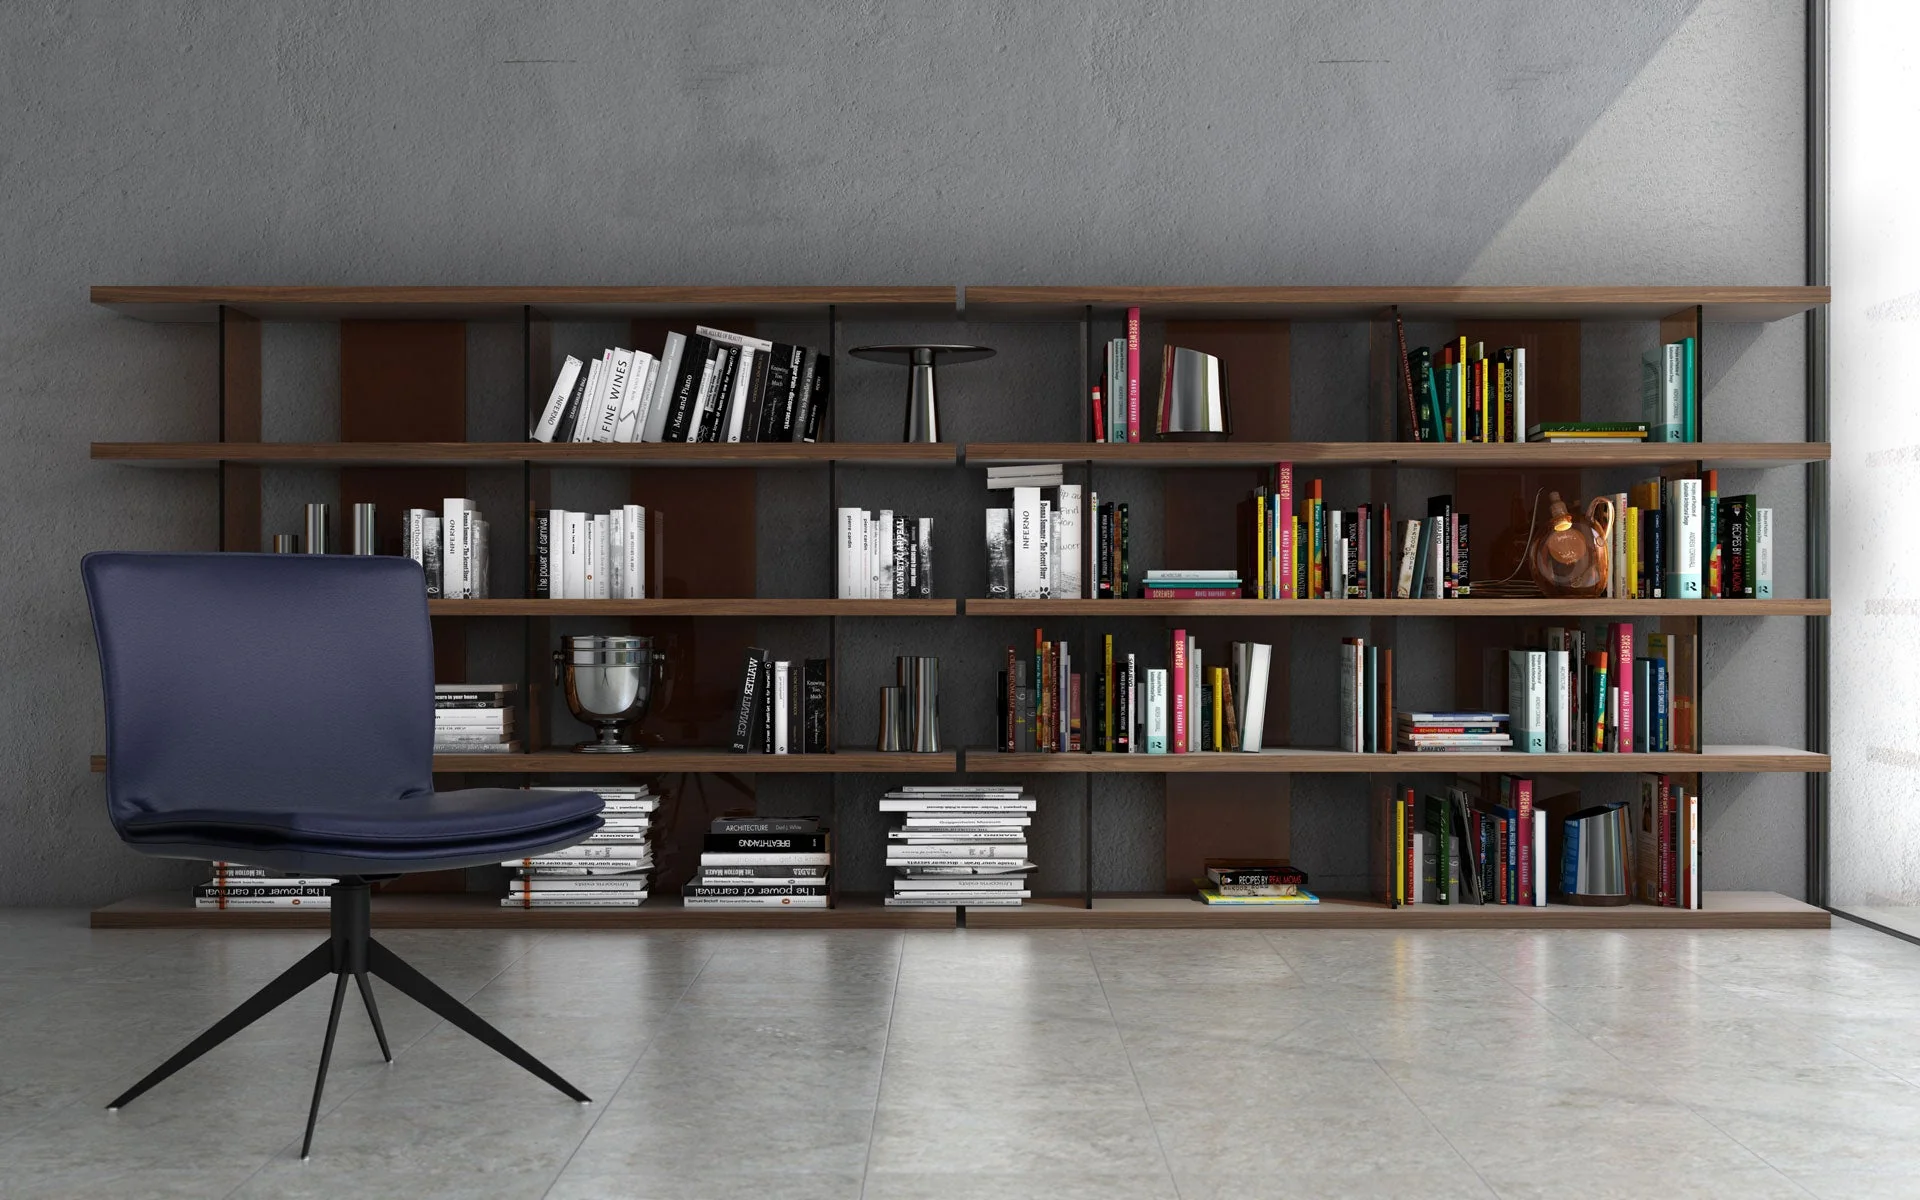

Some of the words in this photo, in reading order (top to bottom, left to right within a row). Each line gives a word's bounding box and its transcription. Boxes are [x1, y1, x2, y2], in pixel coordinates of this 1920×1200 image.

[1129, 320, 1138, 350] SCREWED!
[793, 350, 801, 364] Inside
[683, 374, 693, 395] Piano
[602, 404, 617, 433] FINE
[610, 359, 627, 400] WINES
[679, 396, 688, 411] and
[786, 391, 794, 412] discover
[1505, 394, 1512, 402] BY
[548, 395, 564, 426] INFERNO
[675, 411, 684, 429] Man
[783, 411, 791, 429] secrets
[1281, 468, 1290, 500] SCREWED!
[1040, 503, 1048, 518] Donna
[538, 518, 548, 546] carnival
[896, 519, 904, 552] APPEAL
[1022, 511, 1030, 549] INFERNO
[1040, 519, 1048, 539] Summer
[1460, 524, 1468, 542] YOUNG
[1732, 524, 1742, 548] RECIPES
[538, 546, 548, 554] of
[1040, 542, 1048, 552] The
[1348, 548, 1357, 558] THE
[1458, 548, 1468, 558] THE
[540, 555, 550, 578] power
[1040, 552, 1048, 566] Secret
[1732, 556, 1742, 571] REAL
[896, 552, 904, 595] MAGNETIC
[1040, 567, 1048, 579] Story
[1348, 560, 1357, 578] SHACK
[1458, 560, 1468, 579] SHACK
[1732, 572, 1742, 592] MOMS
[1176, 640, 1184, 668] SCREWED!
[1621, 634, 1630, 664] SCREWED!
[1520, 791, 1530, 819] SCREWED!
[726, 824, 768, 832] ARCHITECTURE
[738, 840, 790, 848] BREATHTAKING
[1238, 876, 1260, 884] RECIPES
[1261, 876, 1268, 884] BY
[1269, 876, 1280, 884] REAL
[254, 888, 264, 896] of
[270, 886, 302, 896] power
[695, 888, 738, 896] carnival
[744, 888, 754, 896] of
[758, 884, 792, 896] power
